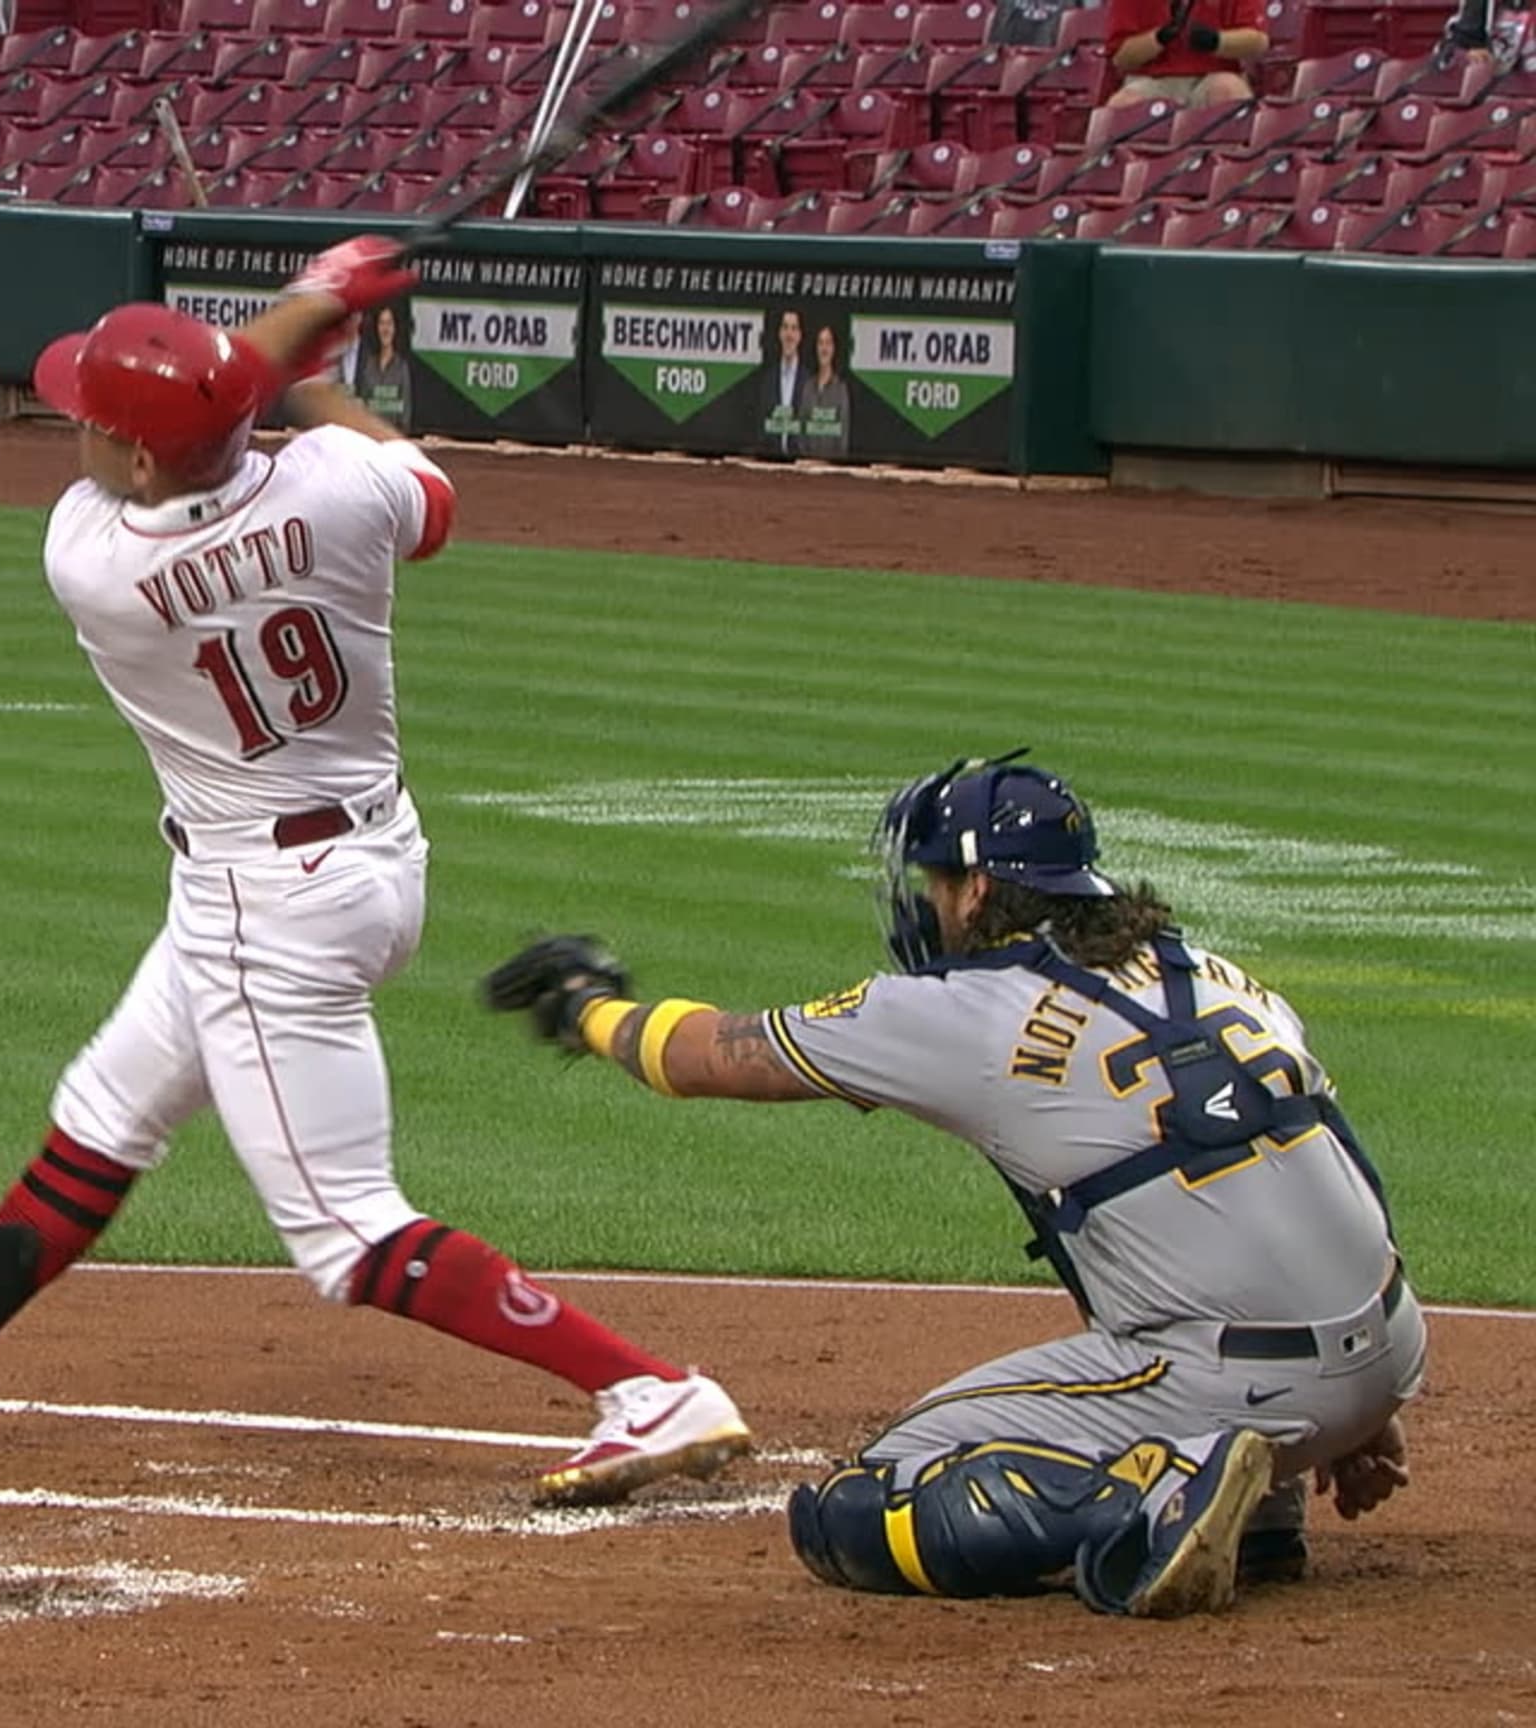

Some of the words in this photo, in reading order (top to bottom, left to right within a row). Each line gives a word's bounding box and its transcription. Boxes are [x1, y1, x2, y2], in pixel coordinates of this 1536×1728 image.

[163, 247, 208, 270] HOME
[215, 249, 237, 270] OF
[243, 250, 273, 272] THE
[479, 262, 581, 289] WARRANTY!
[602, 265, 647, 289] HOME
[653, 268, 672, 290] OF
[680, 269, 712, 292] THE
[717, 270, 795, 296] LIFETIME
[802, 273, 914, 299] POWERTRAIN
[439, 312, 476, 343] MT.
[484, 314, 547, 346] ORAB
[613, 315, 753, 354] BEECHMONT
[879, 329, 916, 363] MT.
[926, 331, 991, 365] ORAB
[467, 361, 519, 389] FORD
[656, 367, 707, 394] FORD
[906, 380, 960, 410] FORD
[136, 516, 313, 634] VOTTO
[192, 606, 349, 763] 19
